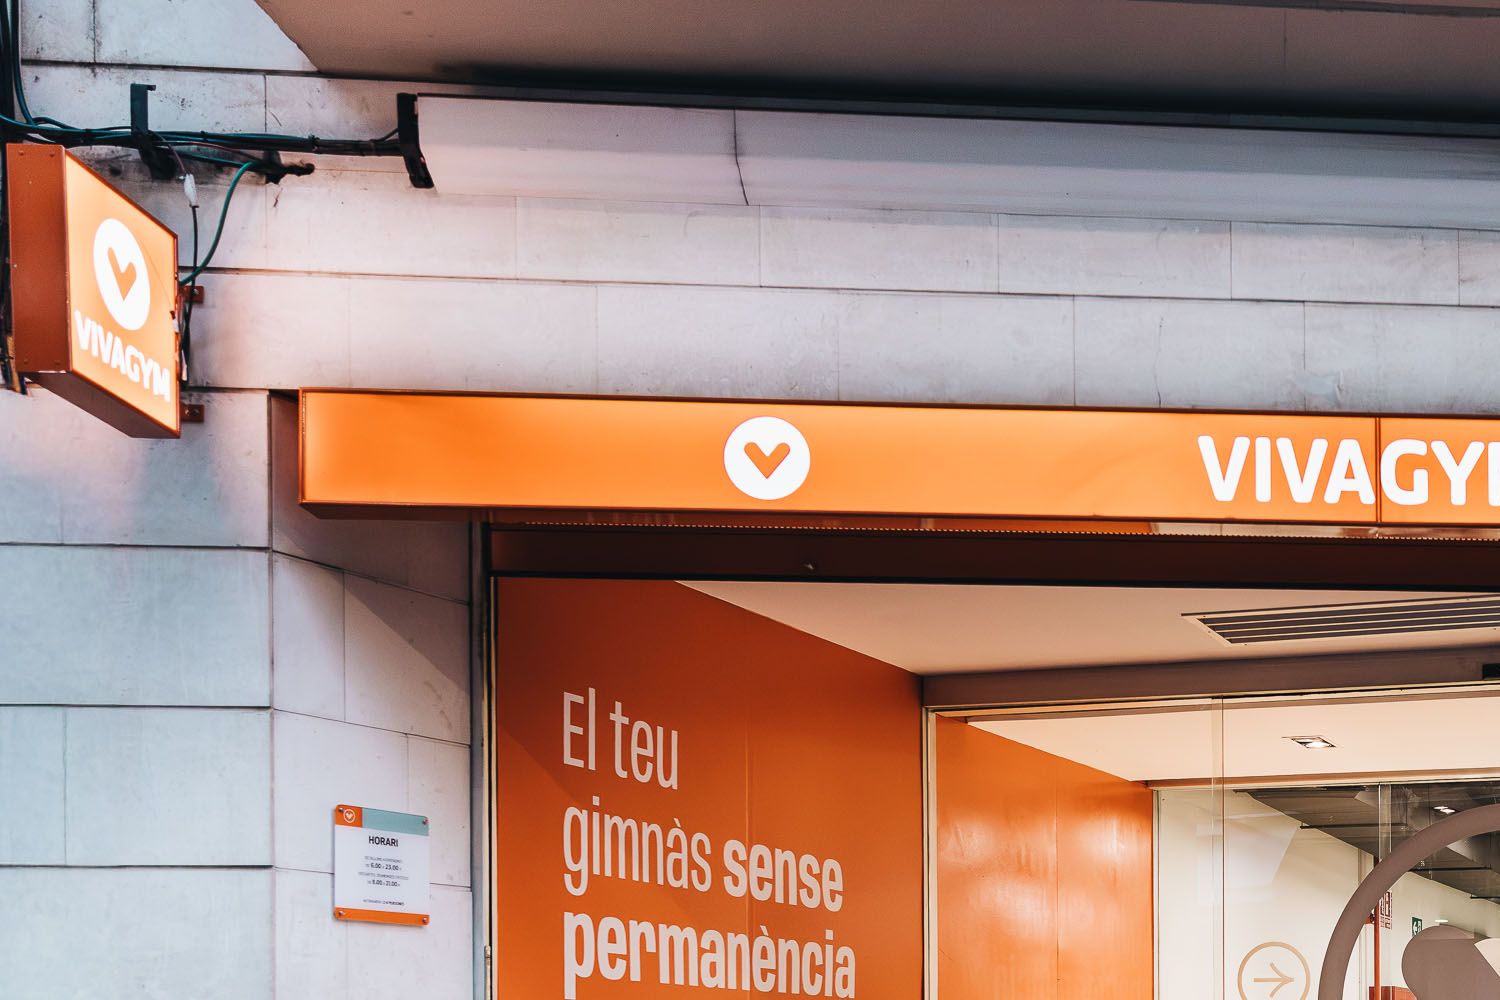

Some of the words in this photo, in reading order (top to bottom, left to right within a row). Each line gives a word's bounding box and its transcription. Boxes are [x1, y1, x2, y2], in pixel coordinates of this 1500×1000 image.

[74, 309, 171, 403] VIVAGYM
[563, 687, 596, 771] El
[609, 701, 678, 790] teu
[368, 835, 398, 847] HORARI
[563, 795, 712, 897] gimnàs
[723, 839, 844, 912] sense
[563, 911, 856, 1000] permanència
